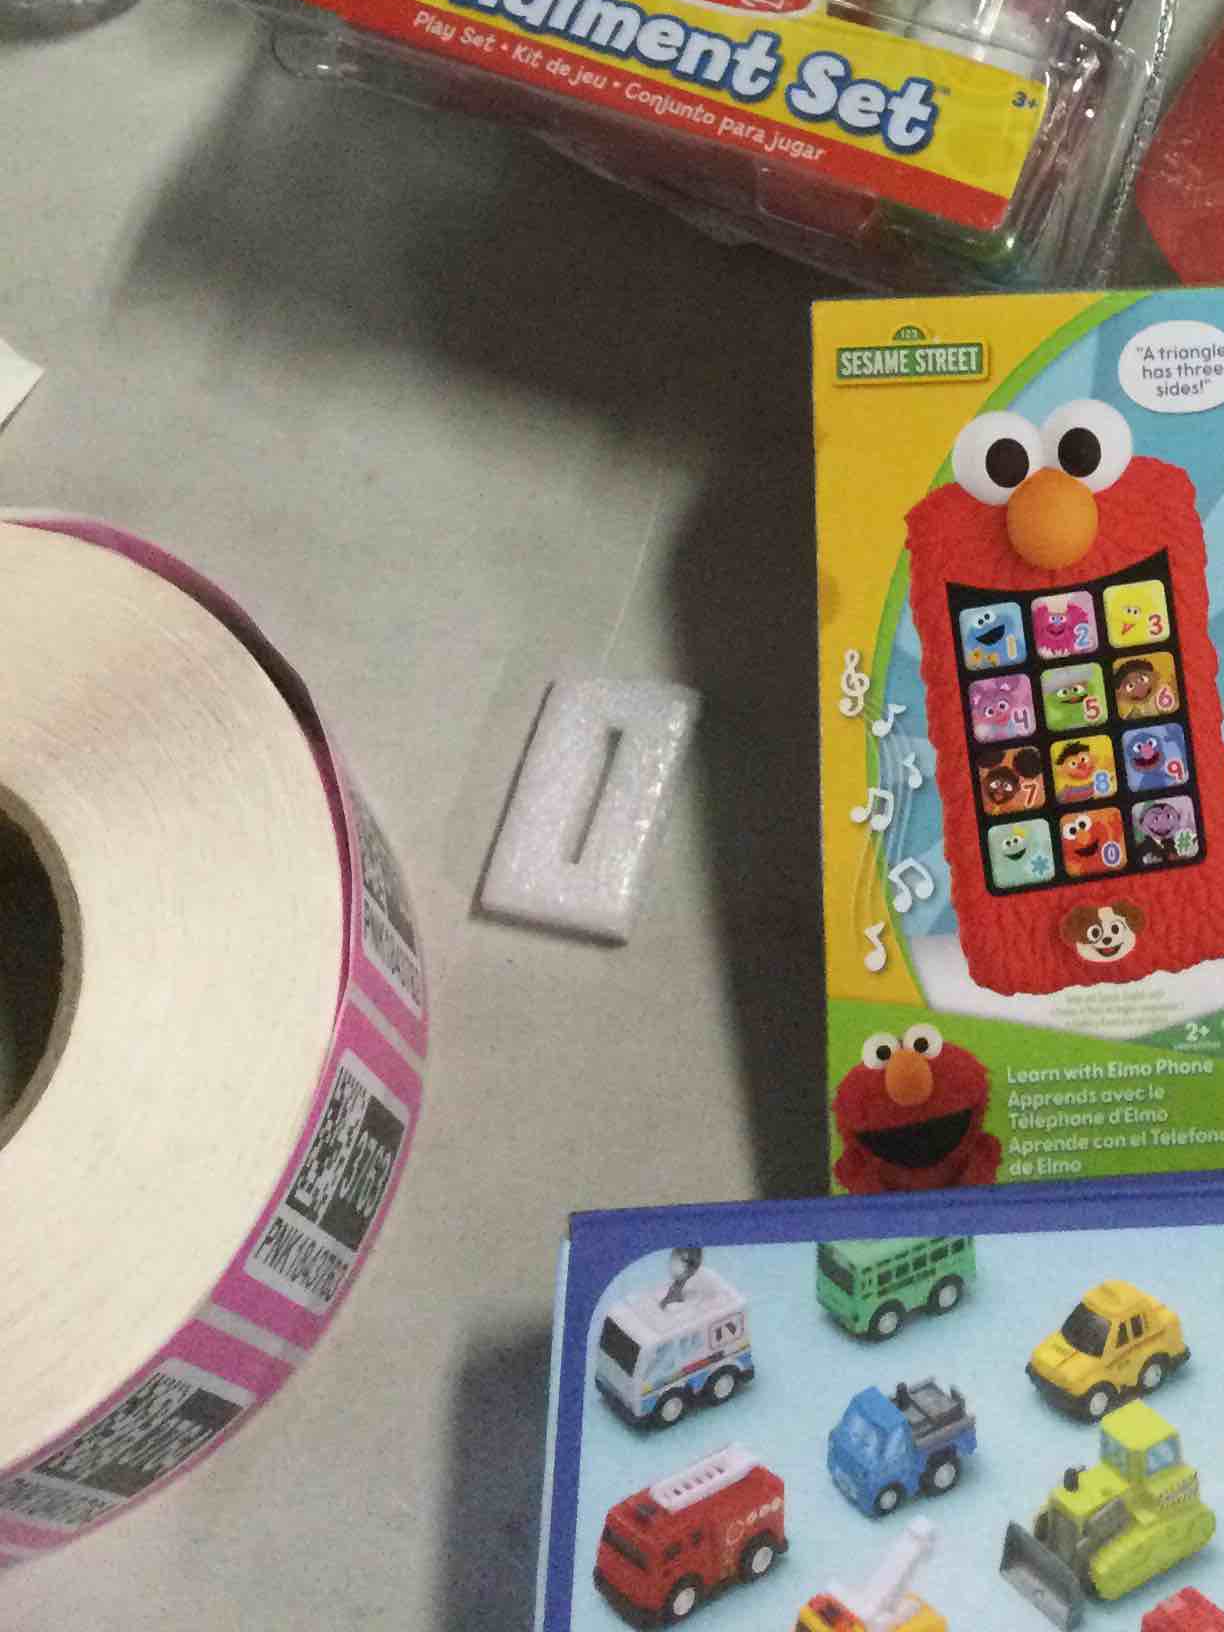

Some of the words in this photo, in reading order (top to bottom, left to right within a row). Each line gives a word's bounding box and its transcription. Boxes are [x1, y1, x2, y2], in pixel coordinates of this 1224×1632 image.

[413, 9, 457, 42] Play
[459, 26, 497, 53] Set
[511, 43, 544, 68] Kit
[545, 56, 571, 77] de
[568, 65, 609, 90] jeu
[624, 81, 717, 125] Conjunto
[718, 116, 766, 145] para
[763, 131, 827, 161] jugar
[787, 52, 938, 154] Set
[1011, 90, 1040, 109] 3+
[839, 347, 909, 377] SESAME
[914, 346, 980, 374] STREET
[1142, 364, 1173, 380] has
[1177, 361, 1224, 380] three
[1073, 623, 1091, 646] 2
[1147, 613, 1165, 635] 3
[1012, 709, 1029, 731] 4
[1082, 697, 1101, 720] 5
[1156, 687, 1174, 710] 6
[1021, 783, 1040, 808] 7
[1092, 770, 1111, 794] 8
[1166, 759, 1184, 781] 9
[1184, 1022, 1210, 1042] 2+
[1007, 1066, 1060, 1084] Learn
[1062, 1063, 1104, 1081] with
[1107, 1060, 1152, 1079] Elmo
[1155, 1057, 1214, 1076] Phone
[1008, 1088, 1097, 1111] Apprends
[1101, 1089, 1145, 1105] avec
[1148, 1084, 1166, 1101] le
[1008, 1134, 1089, 1157] Aprende
[1092, 1133, 1127, 1150] con
[1129, 1129, 1148, 1148] el
[1008, 1158, 1034, 1178] de
[1036, 1156, 1083, 1175] Elmo
